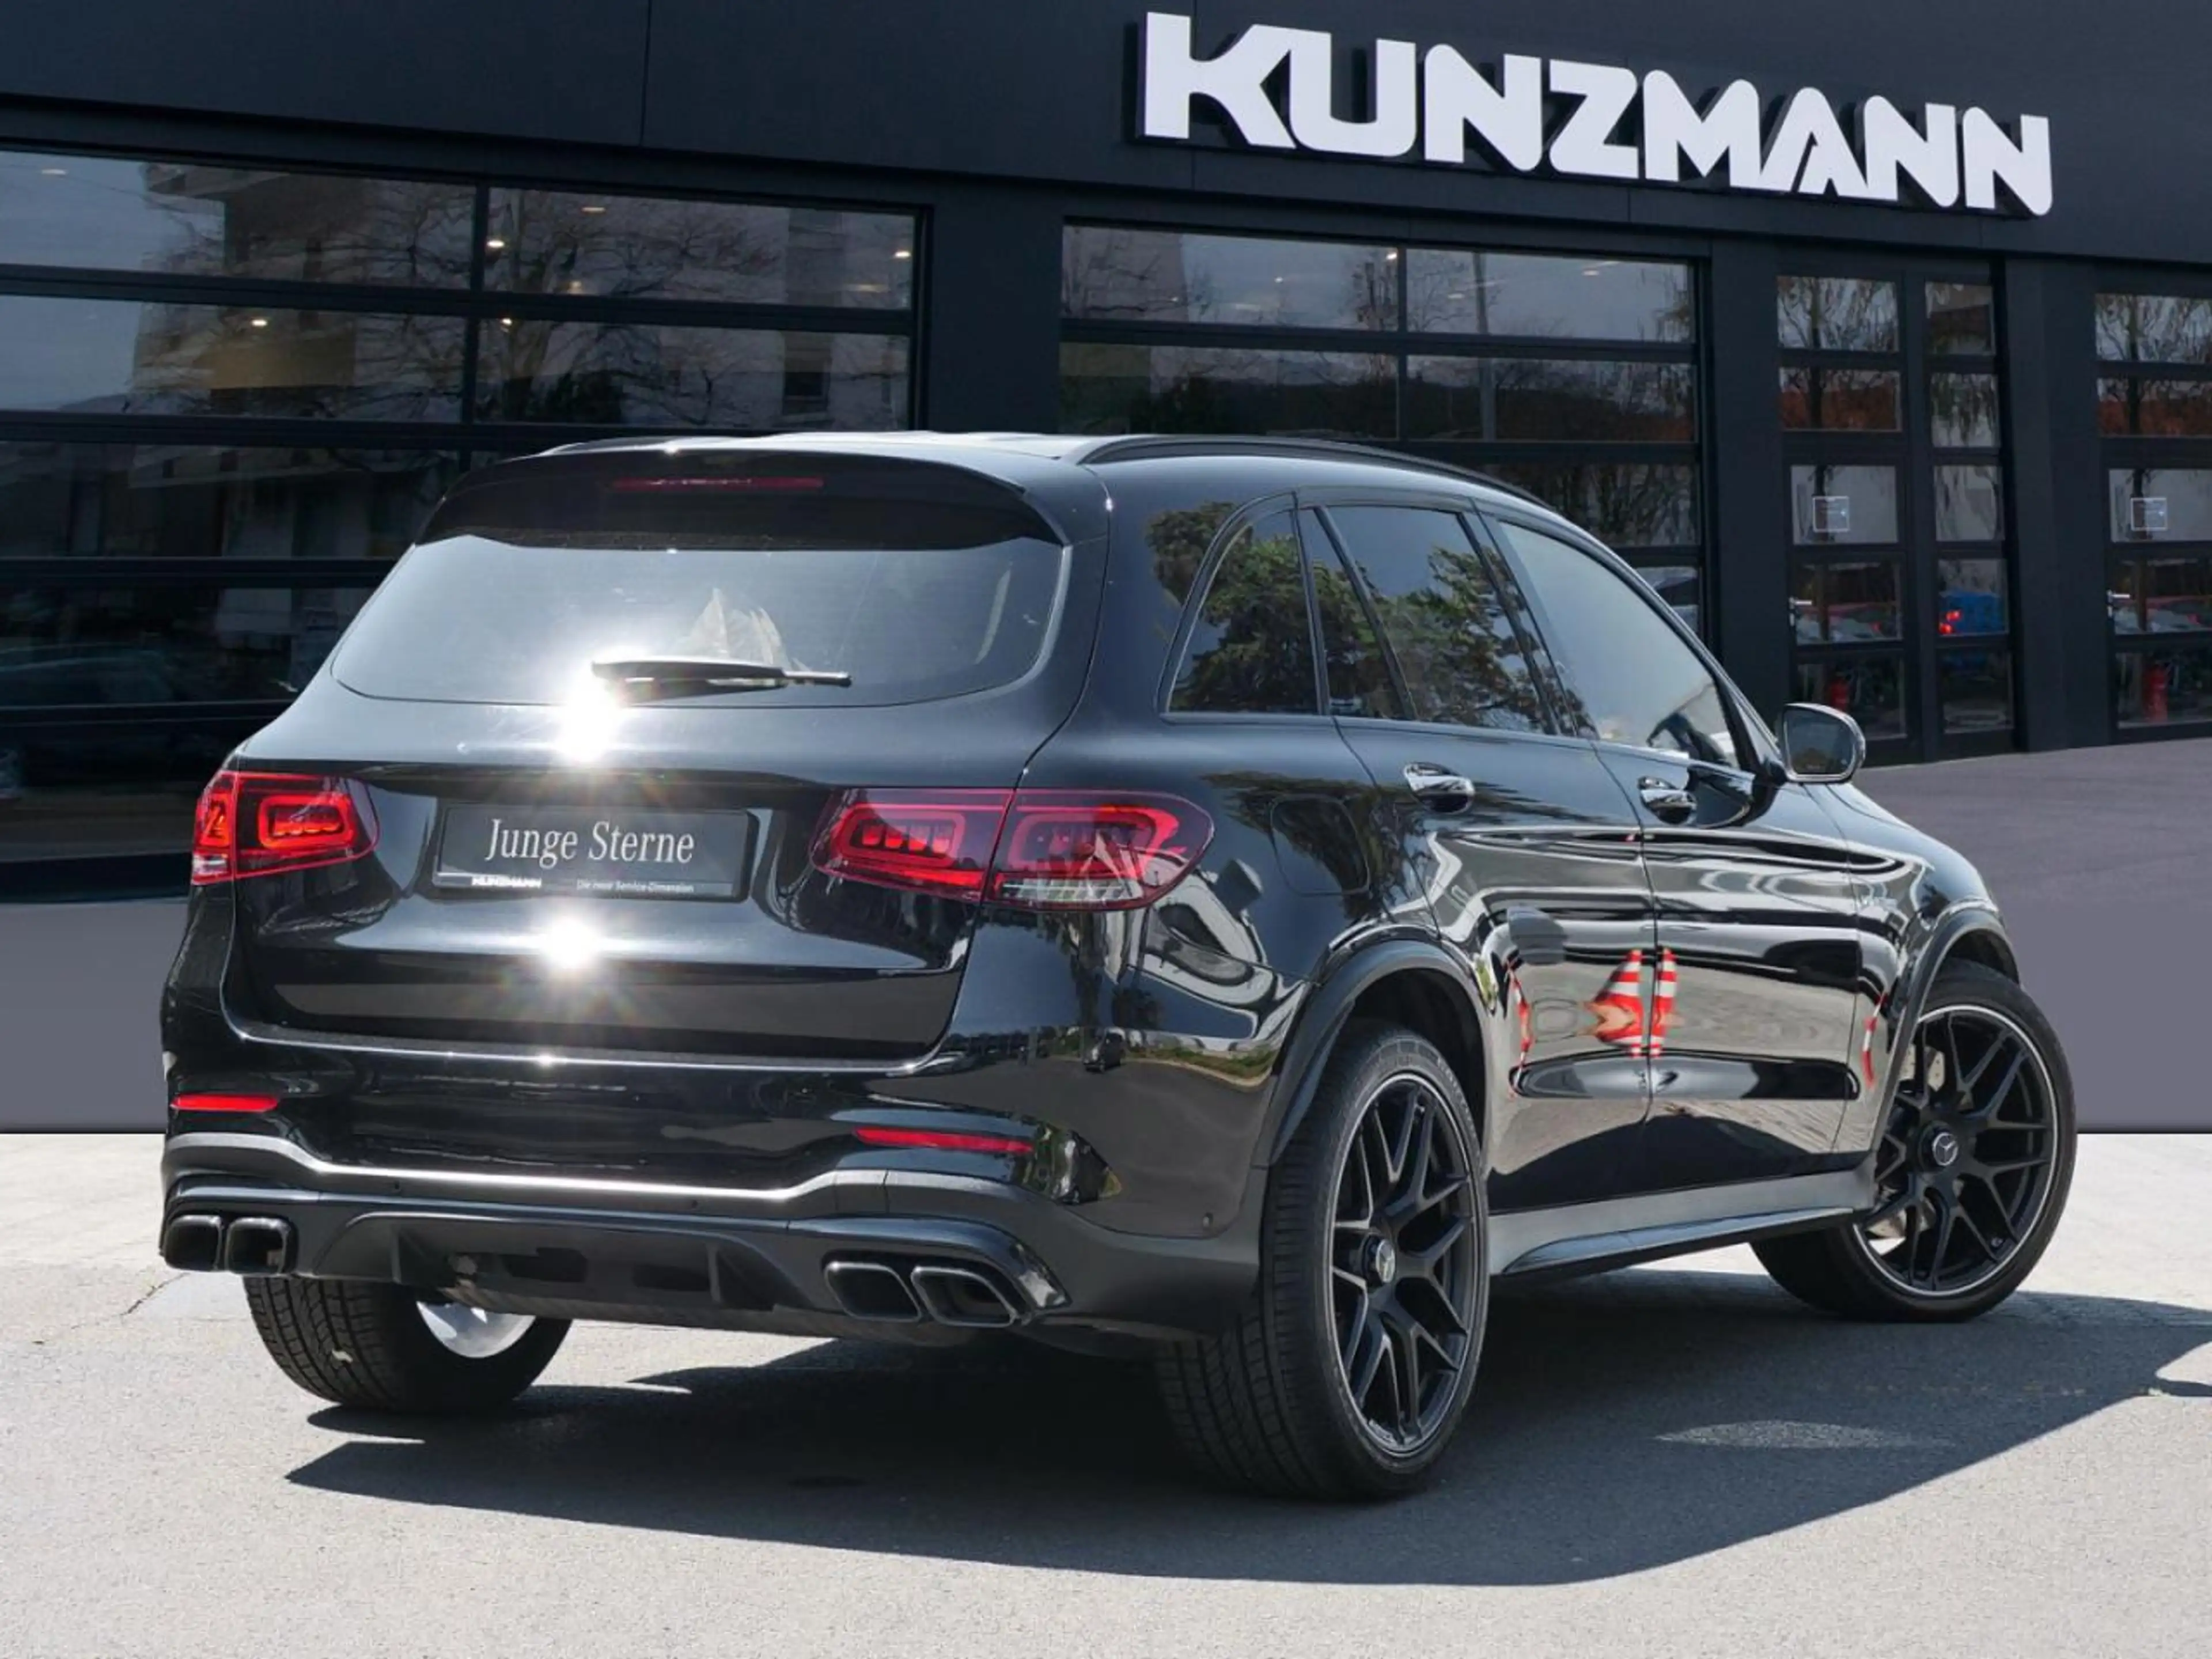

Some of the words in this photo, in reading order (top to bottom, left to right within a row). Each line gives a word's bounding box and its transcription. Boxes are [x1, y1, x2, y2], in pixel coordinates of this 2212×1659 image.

[1144, 12, 2054, 215] KUNZMANN
[485, 818, 578, 869] Junge
[588, 820, 695, 863] Sterne
